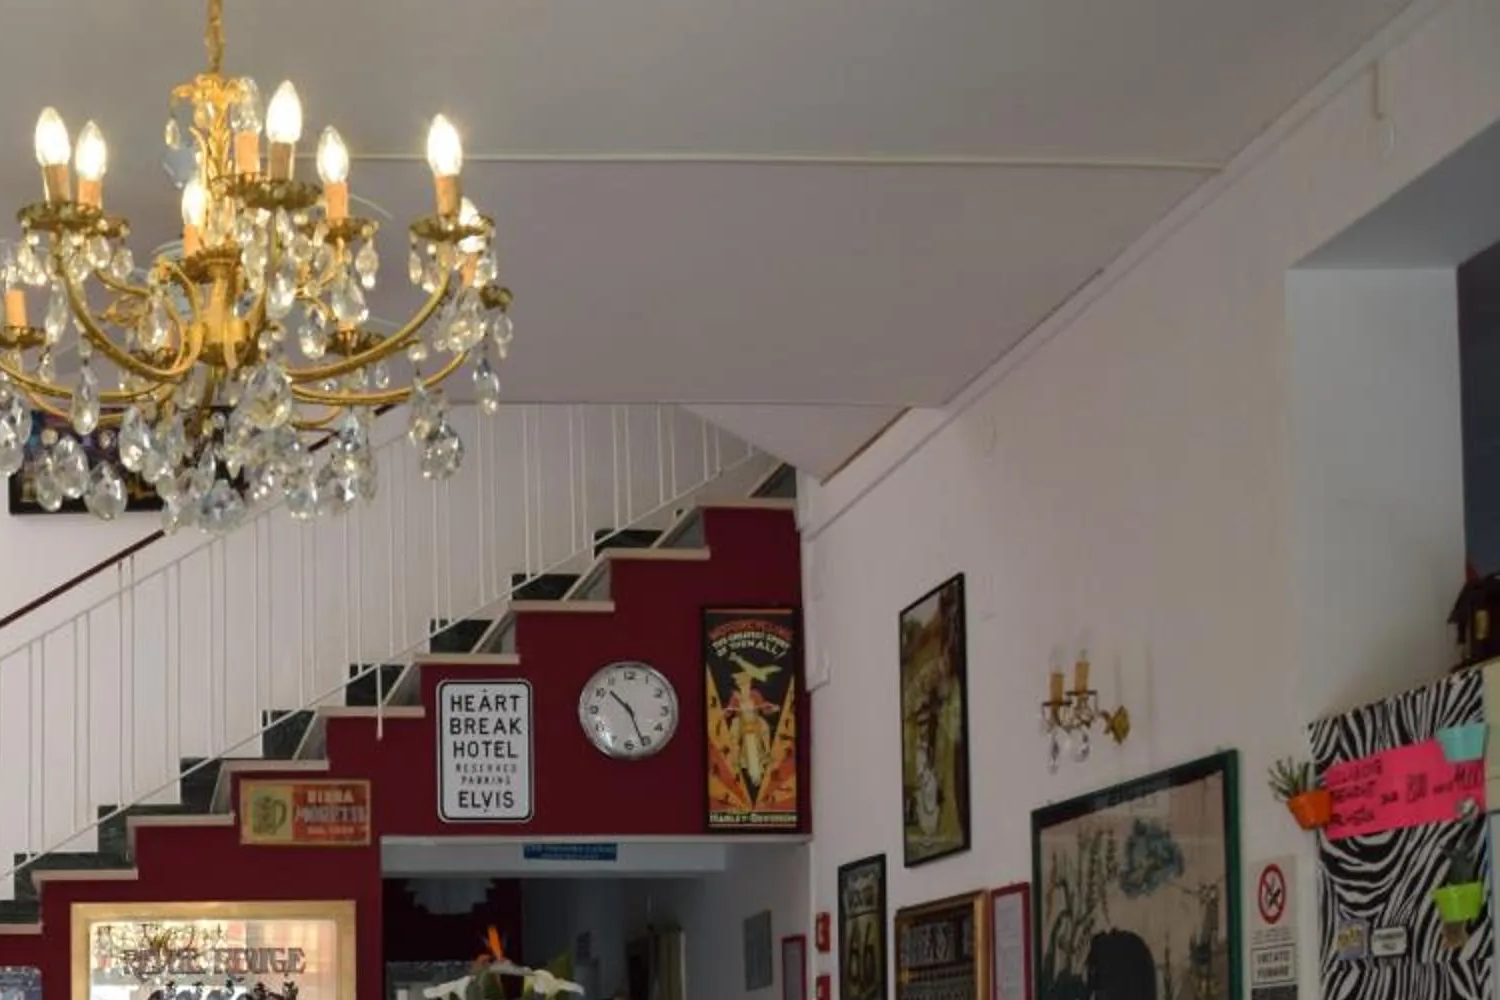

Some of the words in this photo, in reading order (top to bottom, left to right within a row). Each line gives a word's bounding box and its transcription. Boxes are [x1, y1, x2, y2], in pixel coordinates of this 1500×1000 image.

[623, 671, 635, 680] 12
[653, 688, 663, 698] 2
[450, 695, 523, 712] HEART
[660, 706, 669, 716] 3
[450, 717, 523, 735] BREAK
[653, 722, 663, 732] 4
[453, 740, 518, 758] HOTEL
[623, 739, 635, 750] 6
[456, 763, 517, 773] RESERVED
[458, 791, 514, 808] ELVIS
[848, 919, 875, 992] 66
